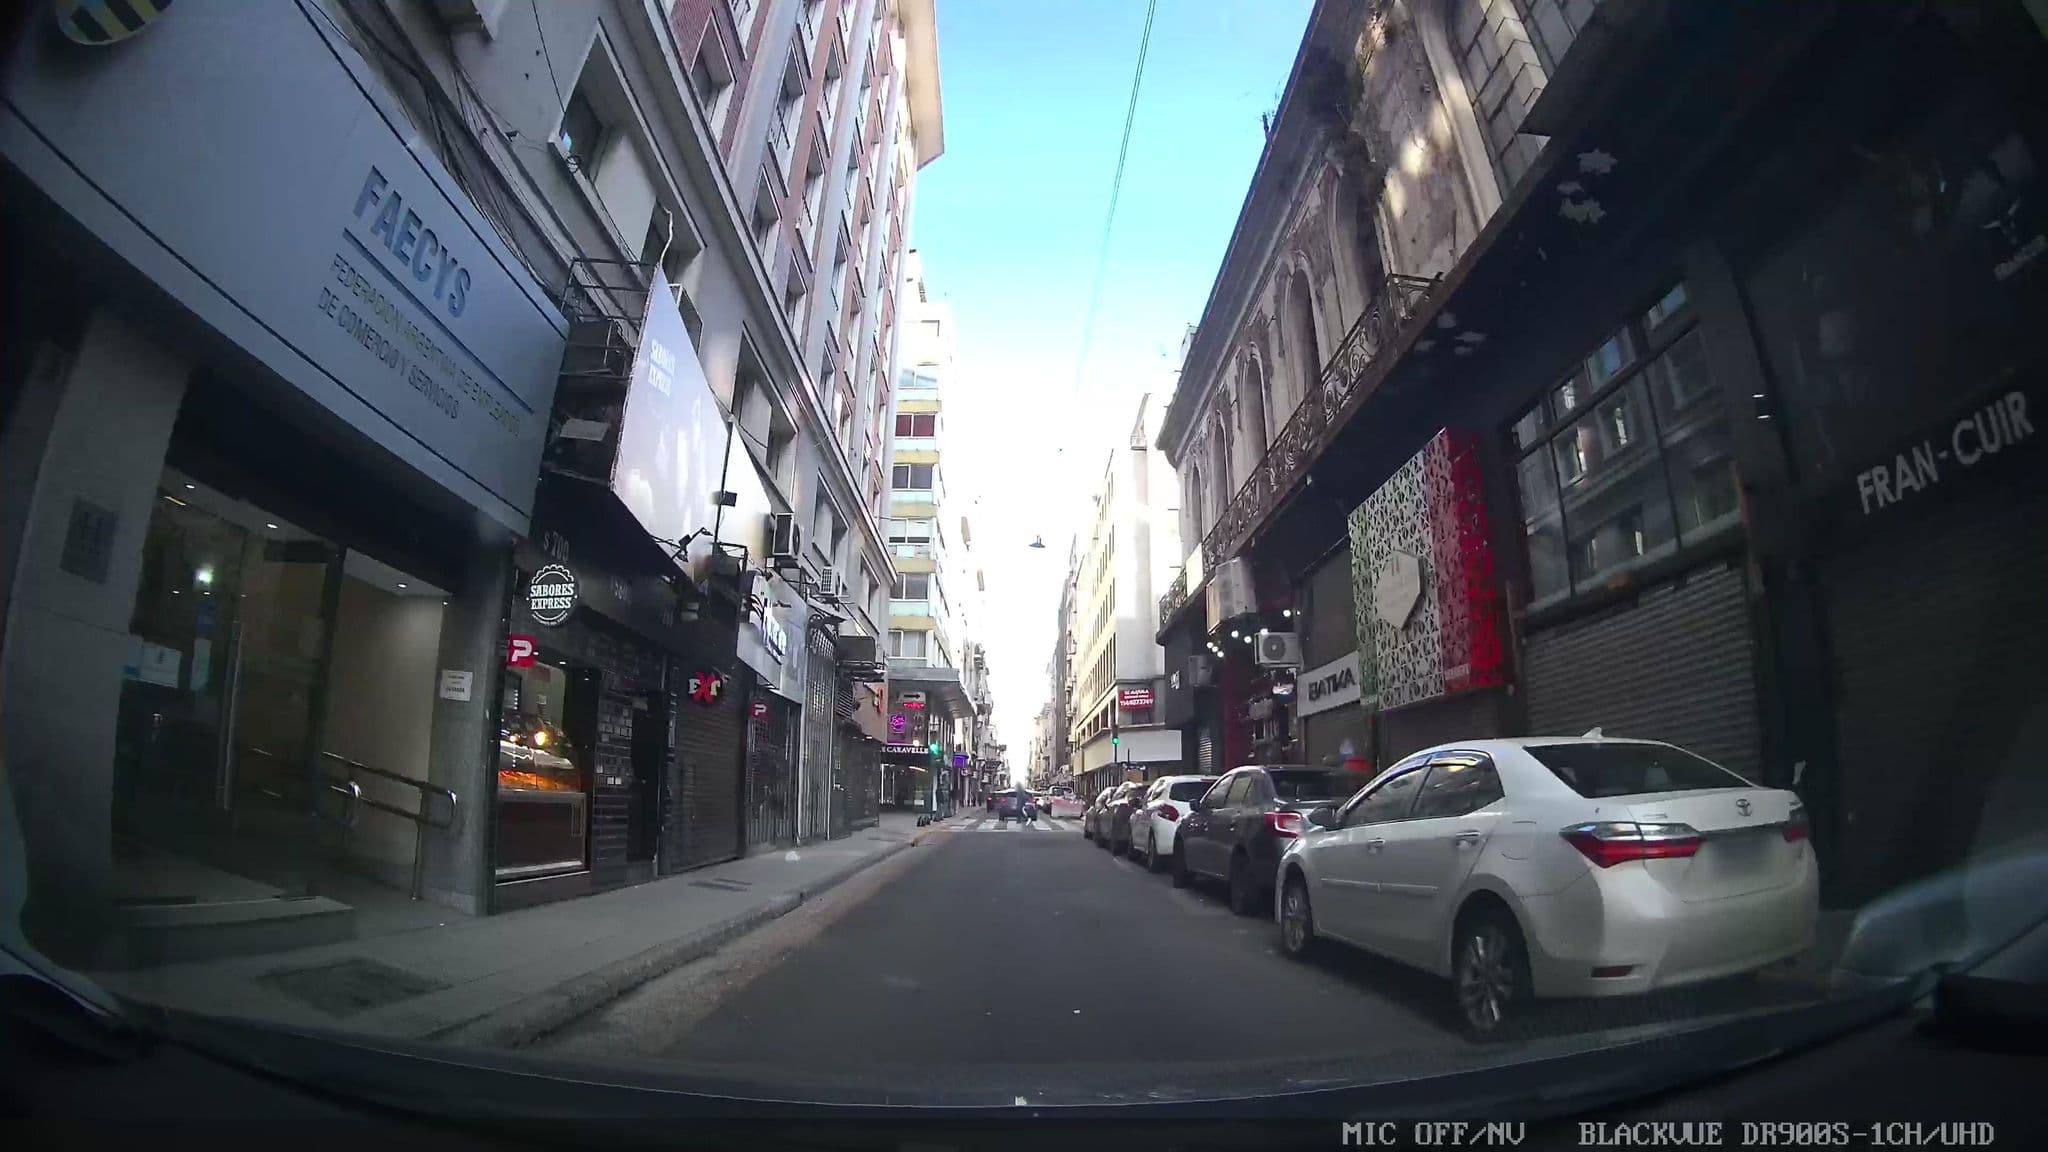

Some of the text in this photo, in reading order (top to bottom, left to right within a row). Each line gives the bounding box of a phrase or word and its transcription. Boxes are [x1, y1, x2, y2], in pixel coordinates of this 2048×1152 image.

[353, 165, 471, 318] FAECYS
[318, 287, 460, 419] DE COMERCIO Y SERVICIOS
[1856, 391, 2034, 515] FRAN-CUIR
[530, 583, 575, 597] SABORES
[531, 597, 572, 610] EXPRESS
[886, 746, 929, 754] CARAVELLE
